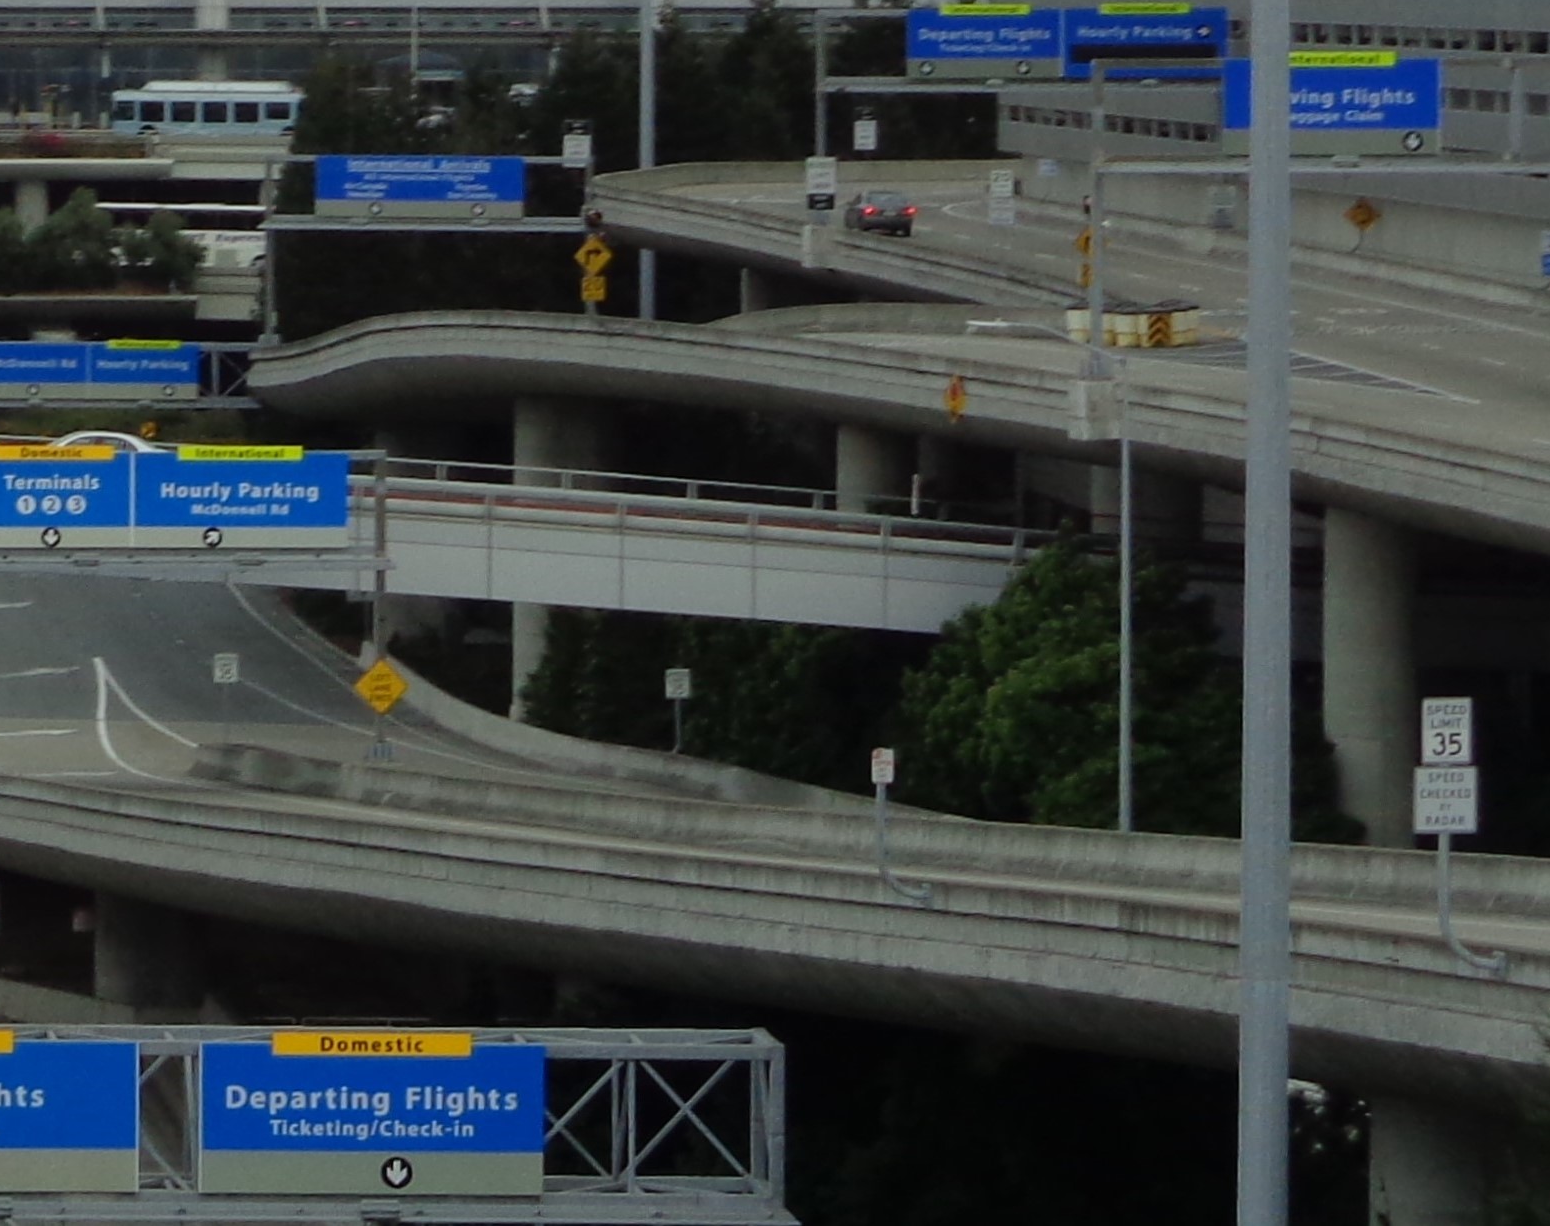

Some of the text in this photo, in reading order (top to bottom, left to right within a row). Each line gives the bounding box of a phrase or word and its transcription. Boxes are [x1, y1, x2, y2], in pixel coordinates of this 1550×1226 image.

[918, 27, 1051, 43] Departing Flights
[1132, 25, 1193, 40] Parking
[1289, 53, 1380, 65] nternational
[1341, 87, 1416, 108] Flights
[19, 447, 83, 458] Domestic
[194, 448, 285, 459] International
[2, 474, 101, 491] Terminals
[160, 481, 320, 503] Hourly Parking
[190, 503, 290, 516] McDonnell Rd
[1426, 704, 1468, 716] SPEED
[1430, 718, 1462, 729] LIMIT
[1432, 732, 1462, 756] 35
[1428, 772, 1465, 784] SPEED
[1419, 788, 1472, 799] CHECKED
[1425, 815, 1466, 826] RADAR
[319, 1036, 425, 1053] Domestic
[224, 1085, 519, 1117] Departing Flights
[268, 1119, 476, 1141] Ticketing/Check-in
